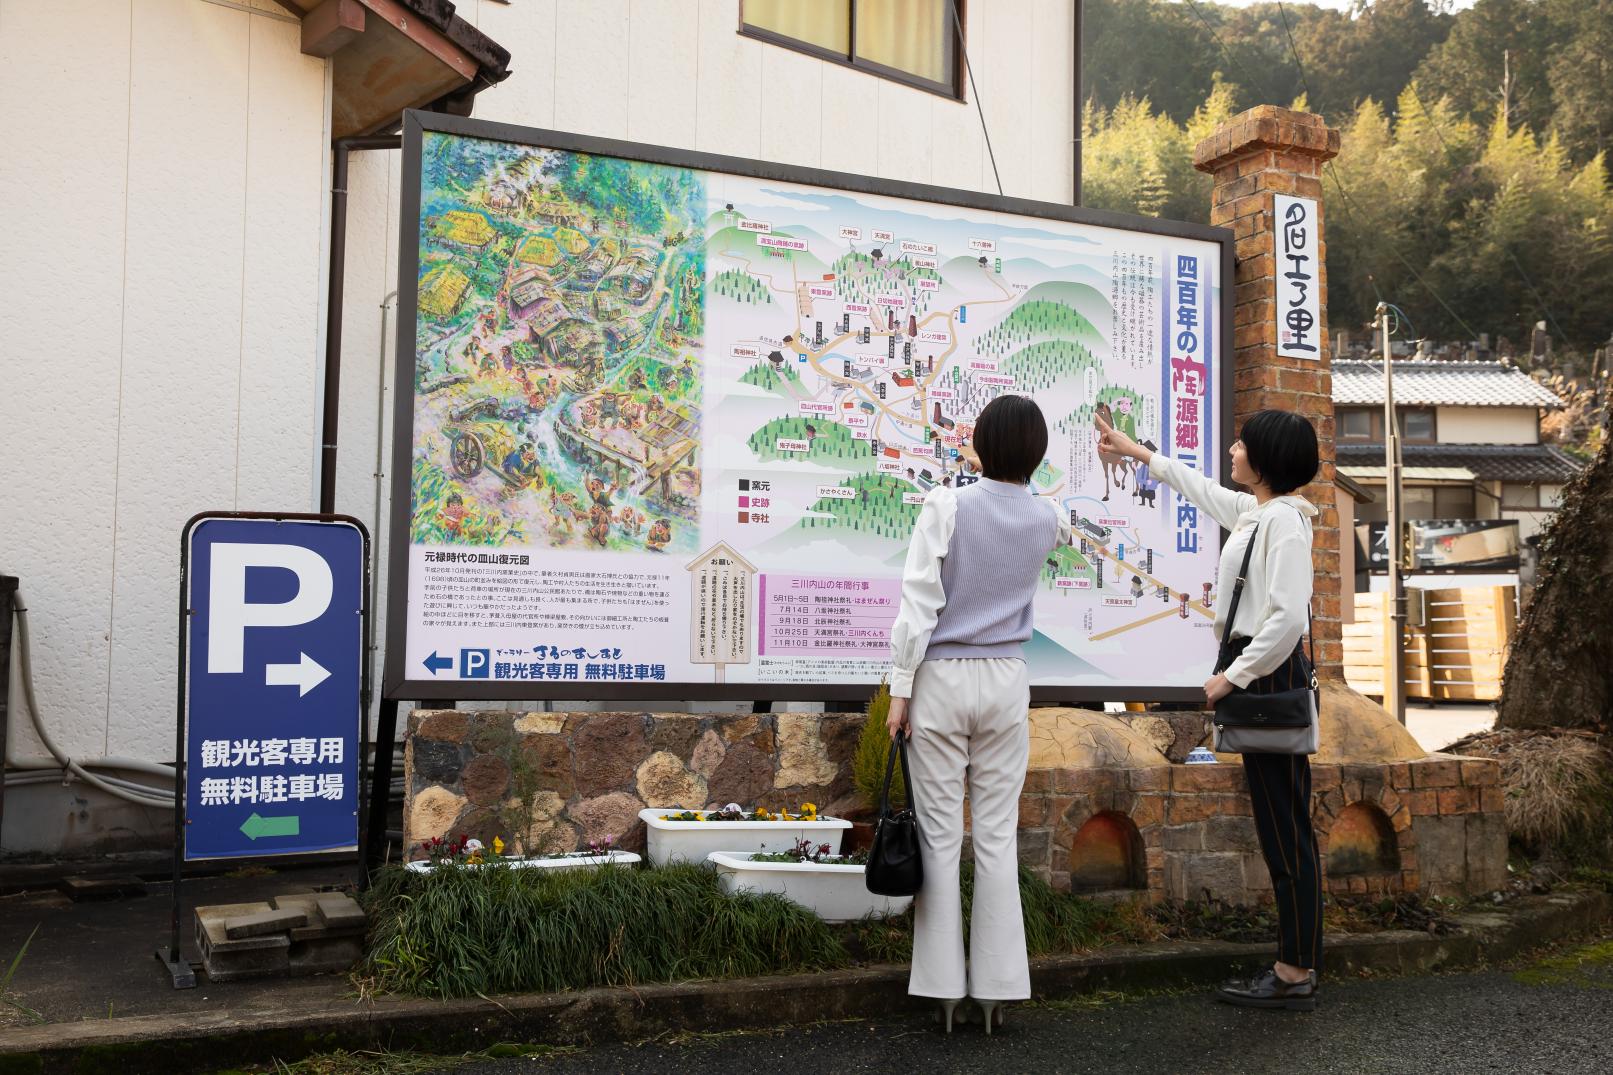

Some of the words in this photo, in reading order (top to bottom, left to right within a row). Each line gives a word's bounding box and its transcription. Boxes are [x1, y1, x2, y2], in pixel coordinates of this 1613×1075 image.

[751, 481, 771, 491] 窯元
[751, 498, 770, 509] 史跡
[751, 513, 770, 524] 寺社
[424, 551, 530, 566] 元禄時代の皿山復元図
[710, 558, 734, 566] お願い
[791, 579, 870, 591] 三川内山の年間行事
[207, 542, 333, 674] P
[780, 606, 809, 614] 7月14日
[774, 628, 809, 636] 10月25日
[774, 639, 808, 647] 11月10日
[467, 651, 486, 675] P
[494, 662, 578, 680] 観光客専用
[585, 663, 666, 681] 無料駐車場
[200, 737, 344, 769] 観光客専用
[200, 773, 344, 806] 無料駐車場
